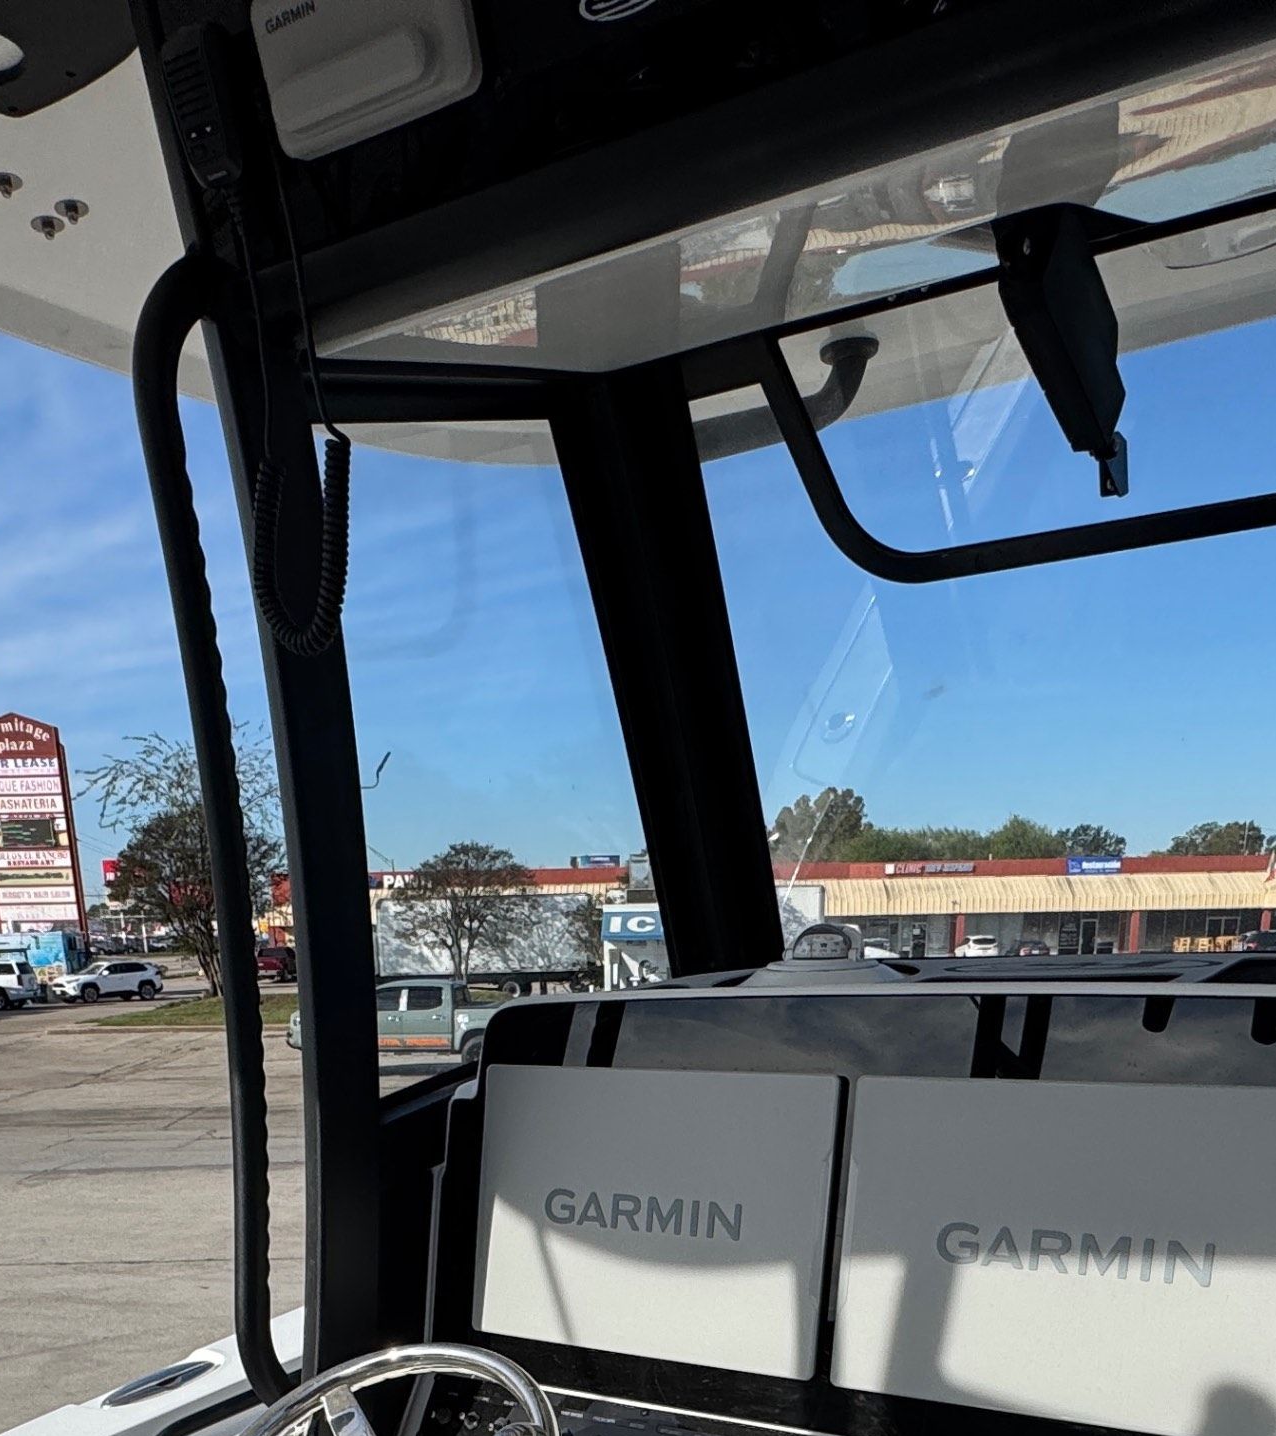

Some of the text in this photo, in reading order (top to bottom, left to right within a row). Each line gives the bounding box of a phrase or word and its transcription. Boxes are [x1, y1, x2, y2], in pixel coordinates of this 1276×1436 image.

[265, 0, 316, 34] GARMIN
[14, 757, 56, 769] LEASE
[20, 779, 60, 792] FASHION
[895, 863, 923, 874] CLINIC
[609, 916, 663, 933] IC
[543, 1187, 744, 1242] GARMIN
[935, 1221, 1216, 1289] GARMIN
